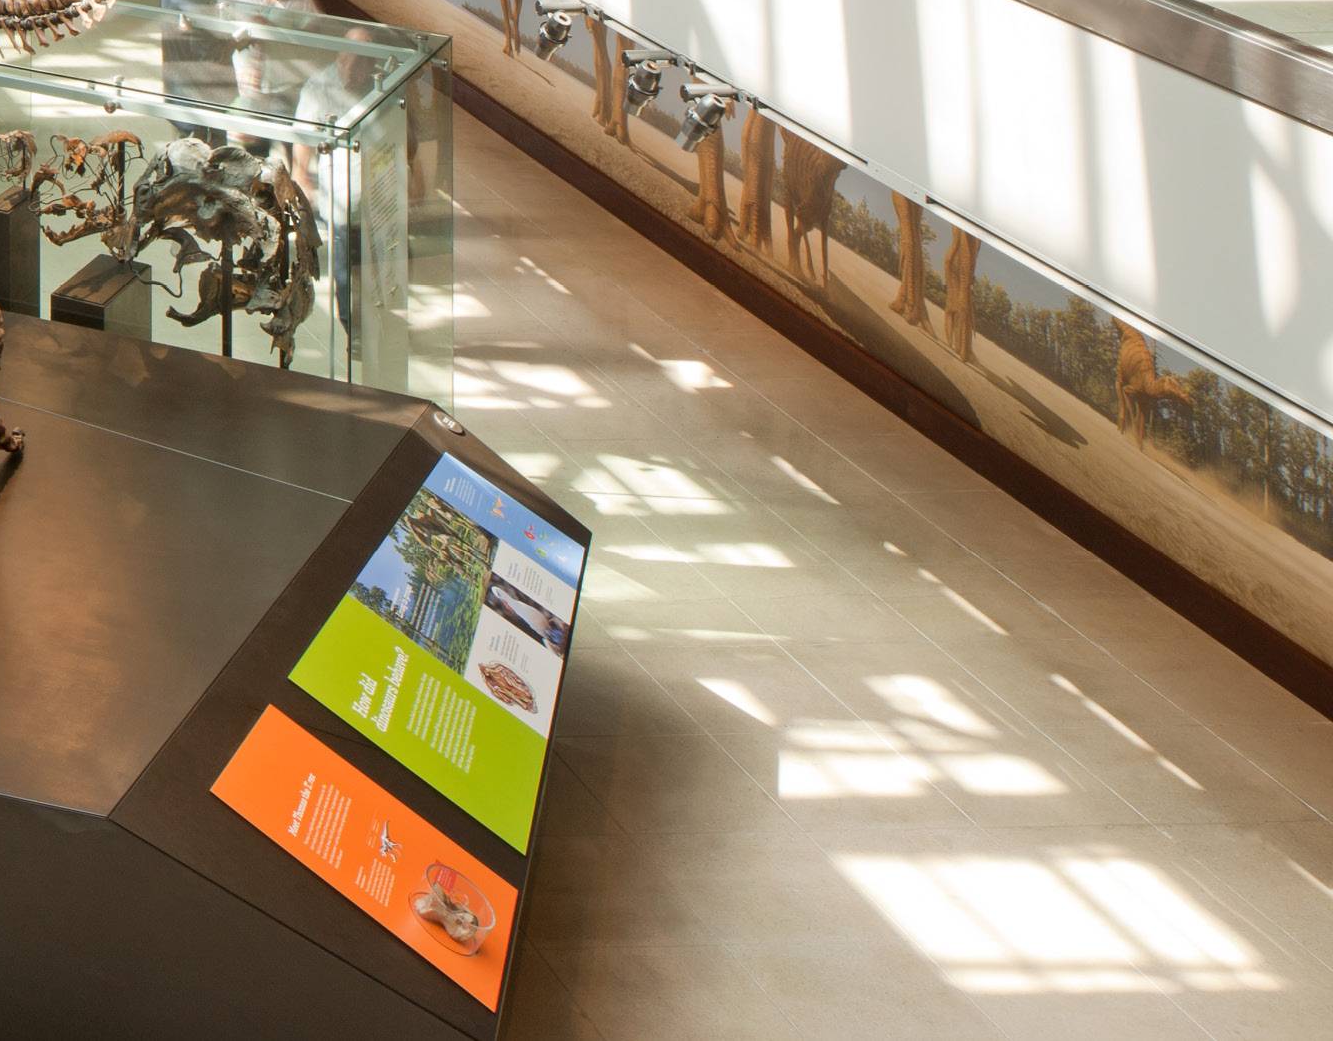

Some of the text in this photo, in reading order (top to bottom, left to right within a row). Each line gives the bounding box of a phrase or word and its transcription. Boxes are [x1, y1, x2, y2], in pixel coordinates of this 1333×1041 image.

[352, 671, 377, 718] How did
[371, 646, 409, 732] dinosaurs behave?
[301, 788, 311, 799] the
